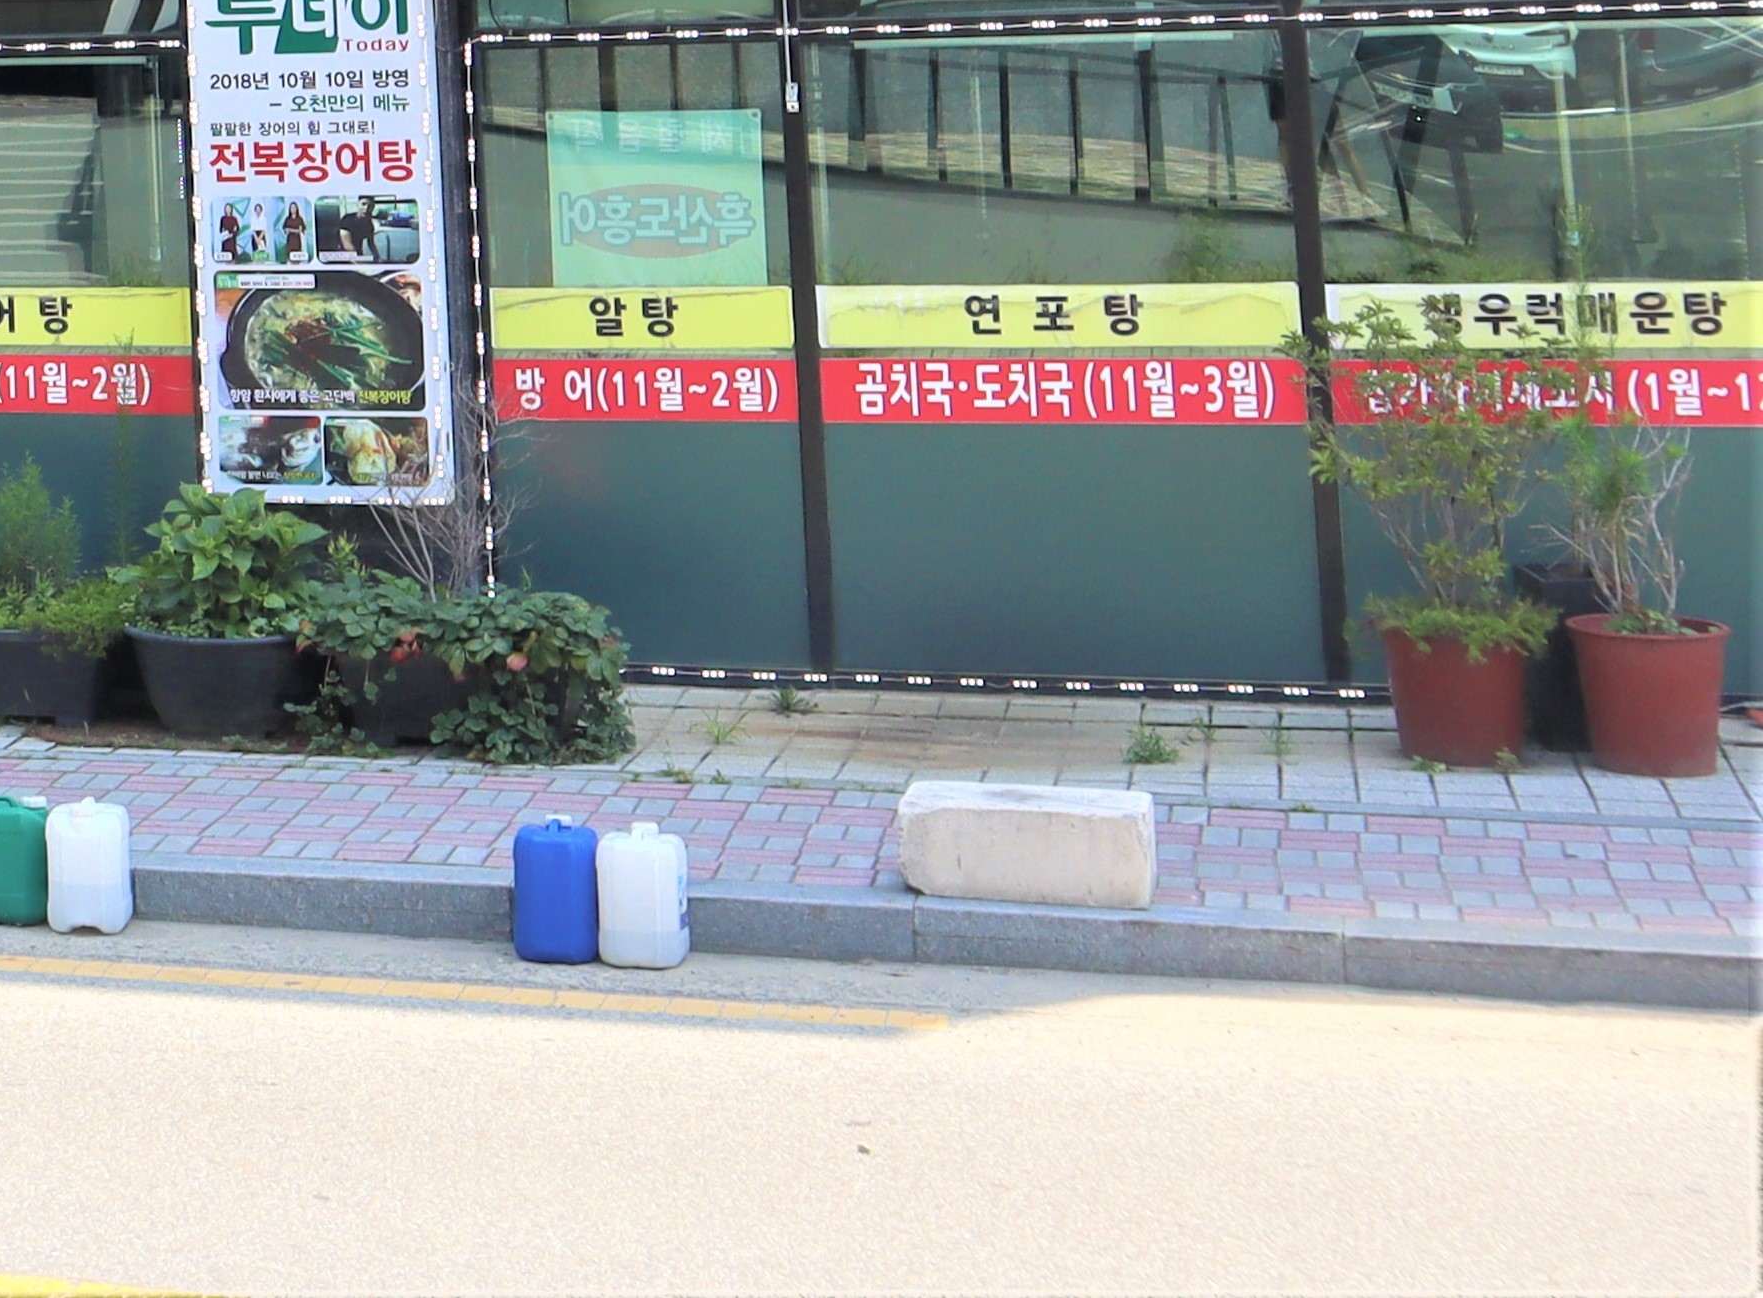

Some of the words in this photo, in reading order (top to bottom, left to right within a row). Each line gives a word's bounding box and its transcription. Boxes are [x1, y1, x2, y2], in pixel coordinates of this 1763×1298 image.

[343, 37, 411, 53] Today
[209, 71, 271, 91] 2018년
[278, 70, 317, 90] 10월
[325, 69, 365, 89] 10일
[372, 69, 410, 88] 방영
[290, 94, 365, 113] 오천만의
[373, 93, 410, 113] 메뉴
[209, 120, 253, 136] 팔팔한
[258, 120, 301, 136] 장어의
[307, 120, 321, 136] 힘
[326, 119, 376, 135] 그대로!
[208, 139, 417, 184] 전복장어탕
[588, 296, 679, 338] 알탕
[964, 294, 1144, 337] 연포탕
[1083, 359, 1275, 419] (11월~3월)
[1627, 367, 1763, 418] (1월~1
